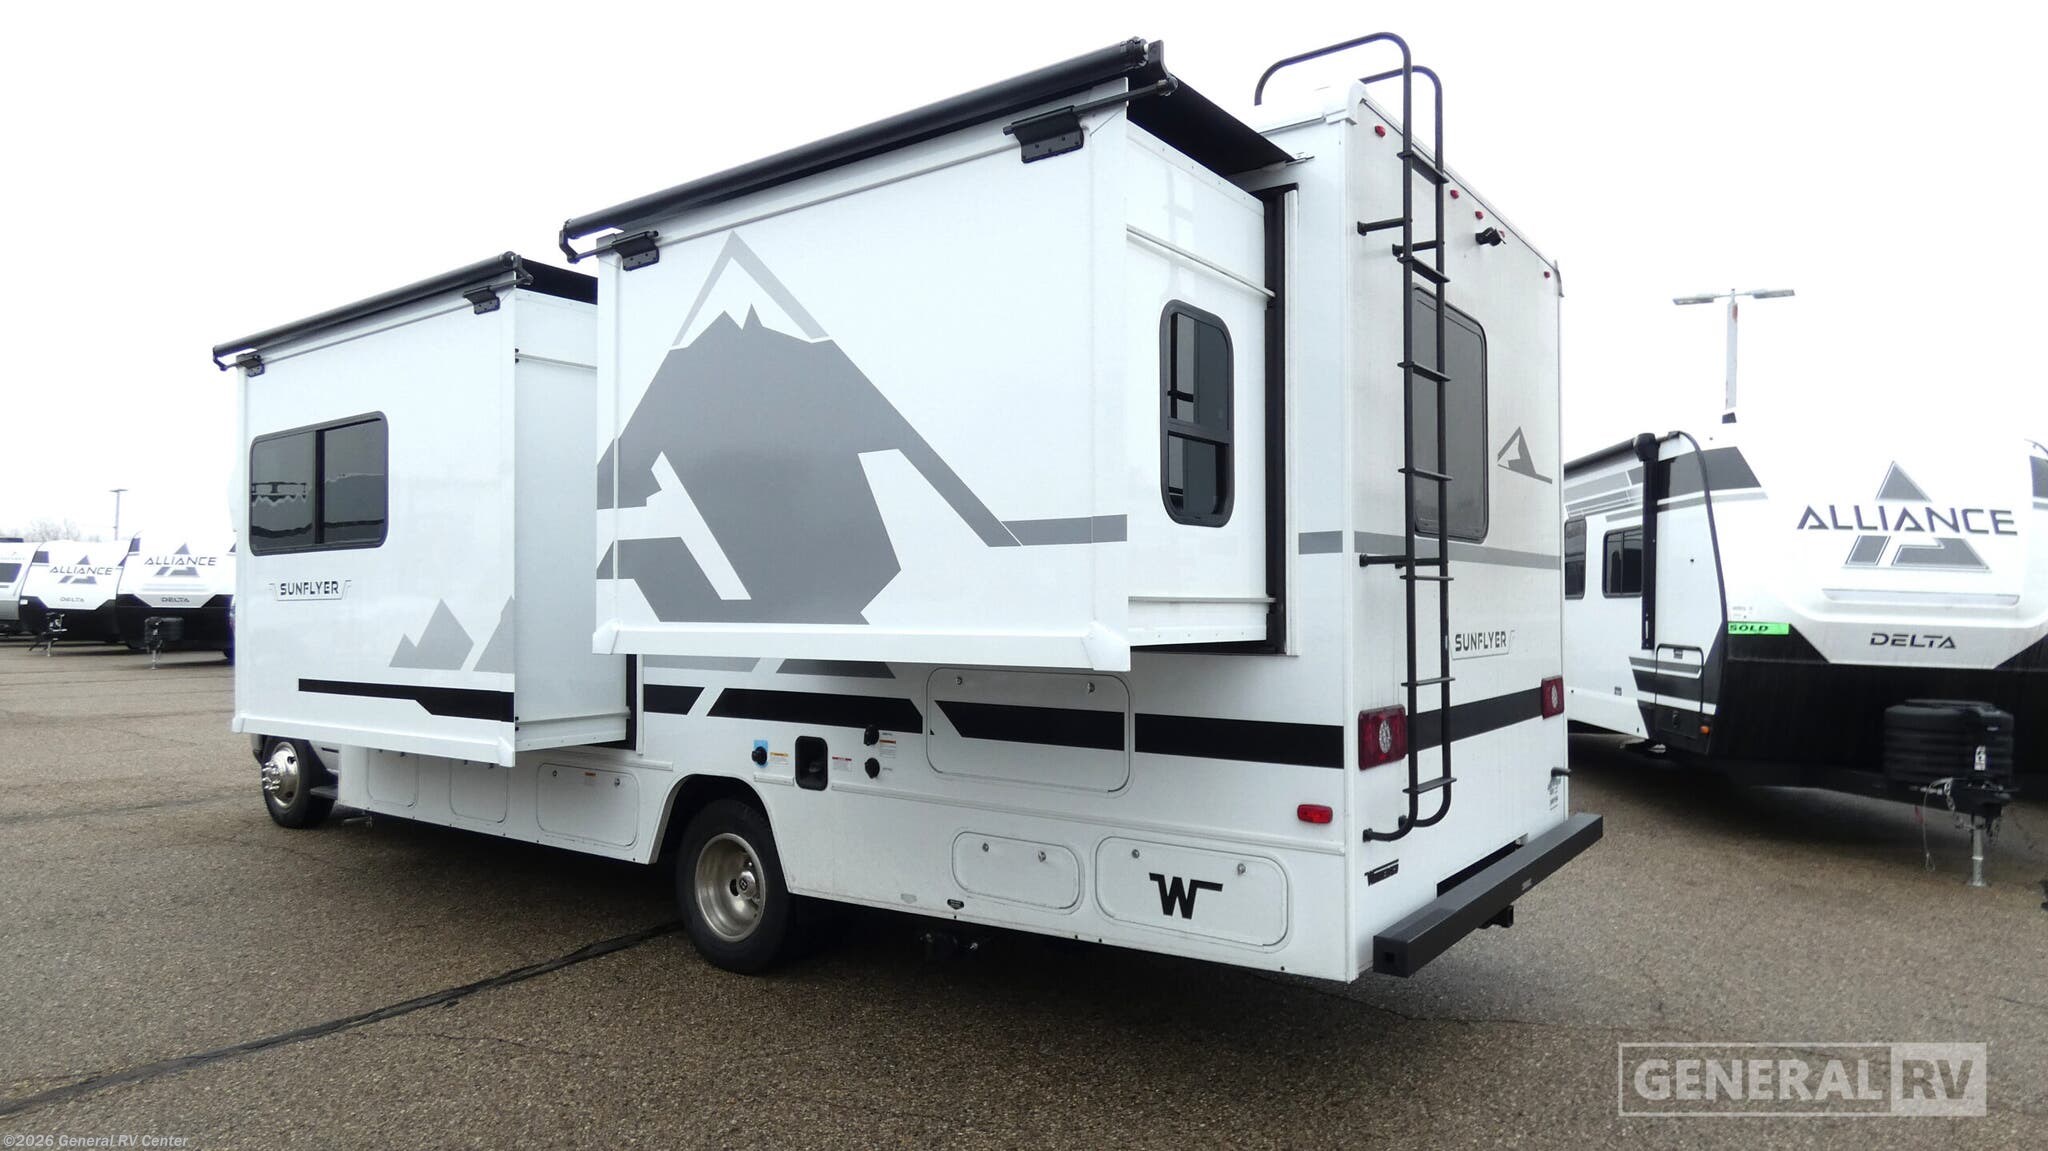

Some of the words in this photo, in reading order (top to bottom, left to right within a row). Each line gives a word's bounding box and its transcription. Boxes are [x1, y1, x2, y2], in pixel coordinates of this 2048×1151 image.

[1797, 505, 2018, 536] ALLIANCE
[144, 556, 217, 567] ALLIANCE
[50, 565, 113, 576] ALLIANCE
[280, 581, 339, 596] SUNFLYER
[160, 596, 190, 604] DELTA
[1729, 624, 1769, 632] SOLD
[1455, 631, 1507, 652] SUNFLYER
[1870, 632, 1957, 650] DELTA
